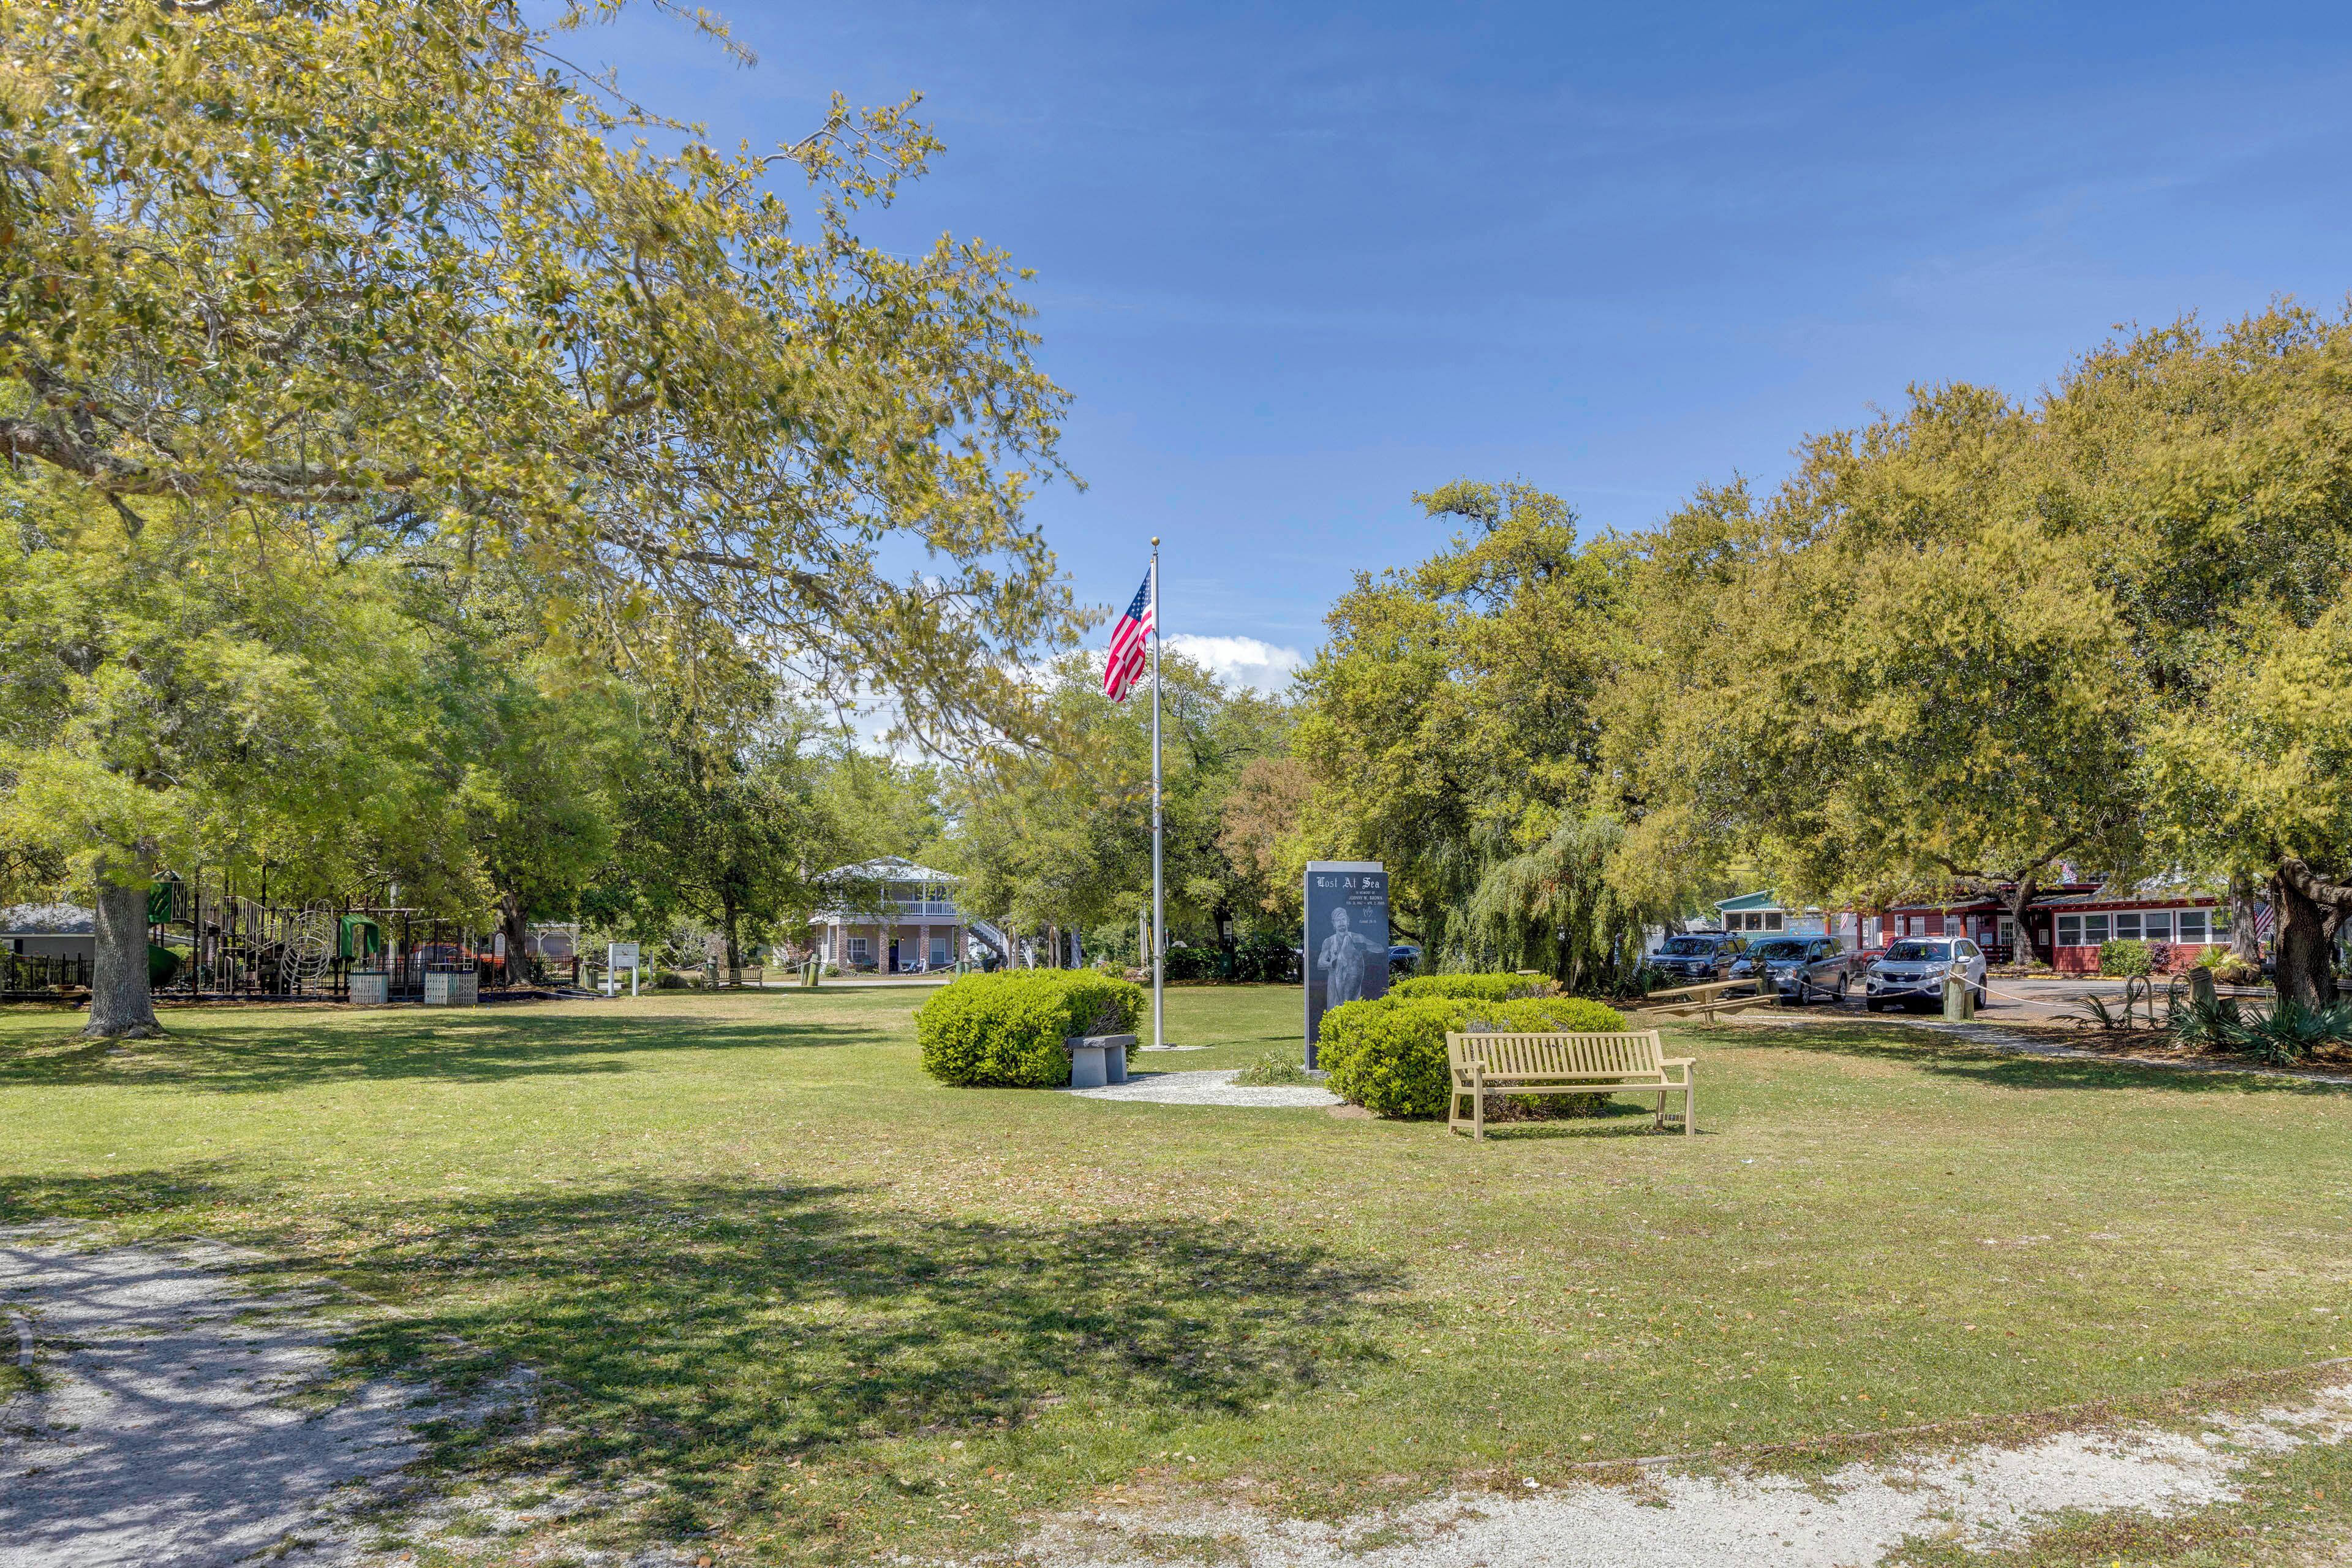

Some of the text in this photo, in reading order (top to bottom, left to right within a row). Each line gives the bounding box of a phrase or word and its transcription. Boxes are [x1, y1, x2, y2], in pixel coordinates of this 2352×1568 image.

[1316, 876, 1380, 889] Lost At Sea
